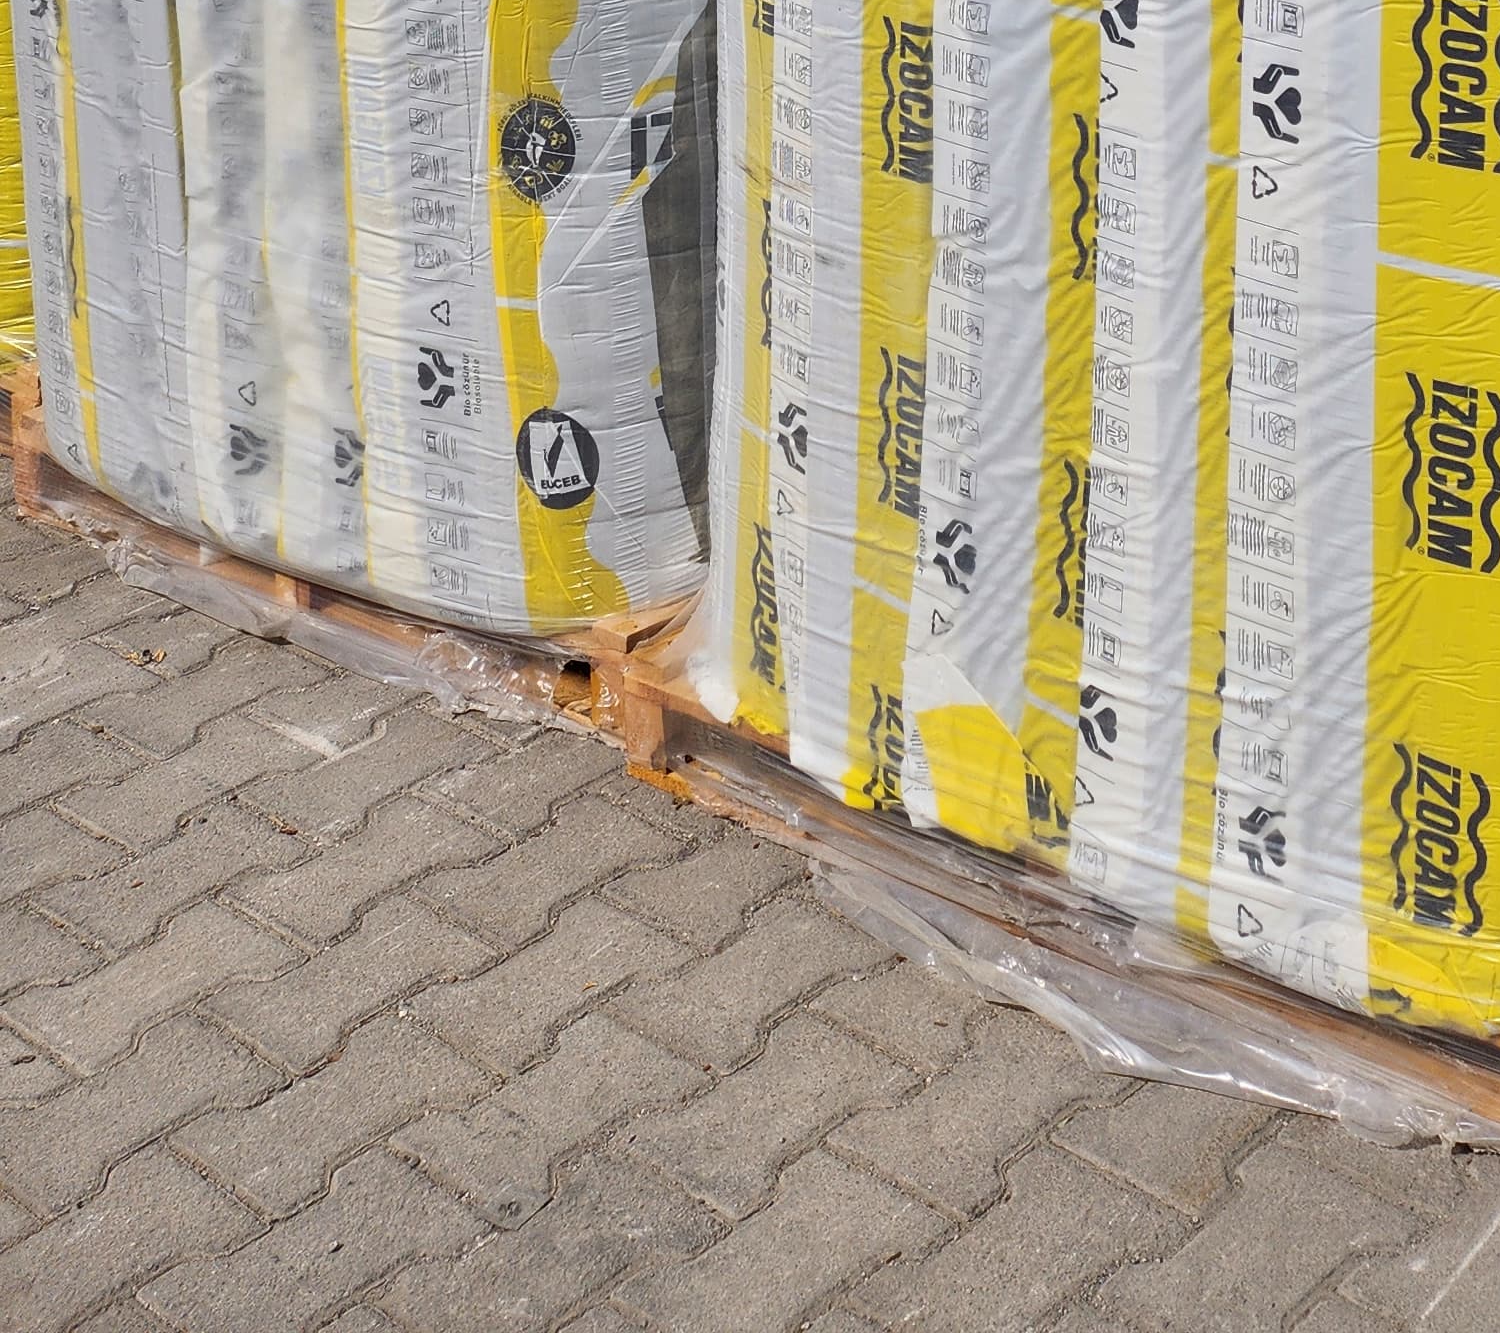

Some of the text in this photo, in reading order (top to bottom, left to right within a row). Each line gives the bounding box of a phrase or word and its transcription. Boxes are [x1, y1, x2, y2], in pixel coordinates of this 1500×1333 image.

[462, 353, 471, 416] Bio çözünür
[472, 359, 482, 413] Biosoluble
[541, 474, 581, 489] EUCEB
[1427, 379, 1478, 570] İZOCAM
[919, 506, 927, 524] Bio
